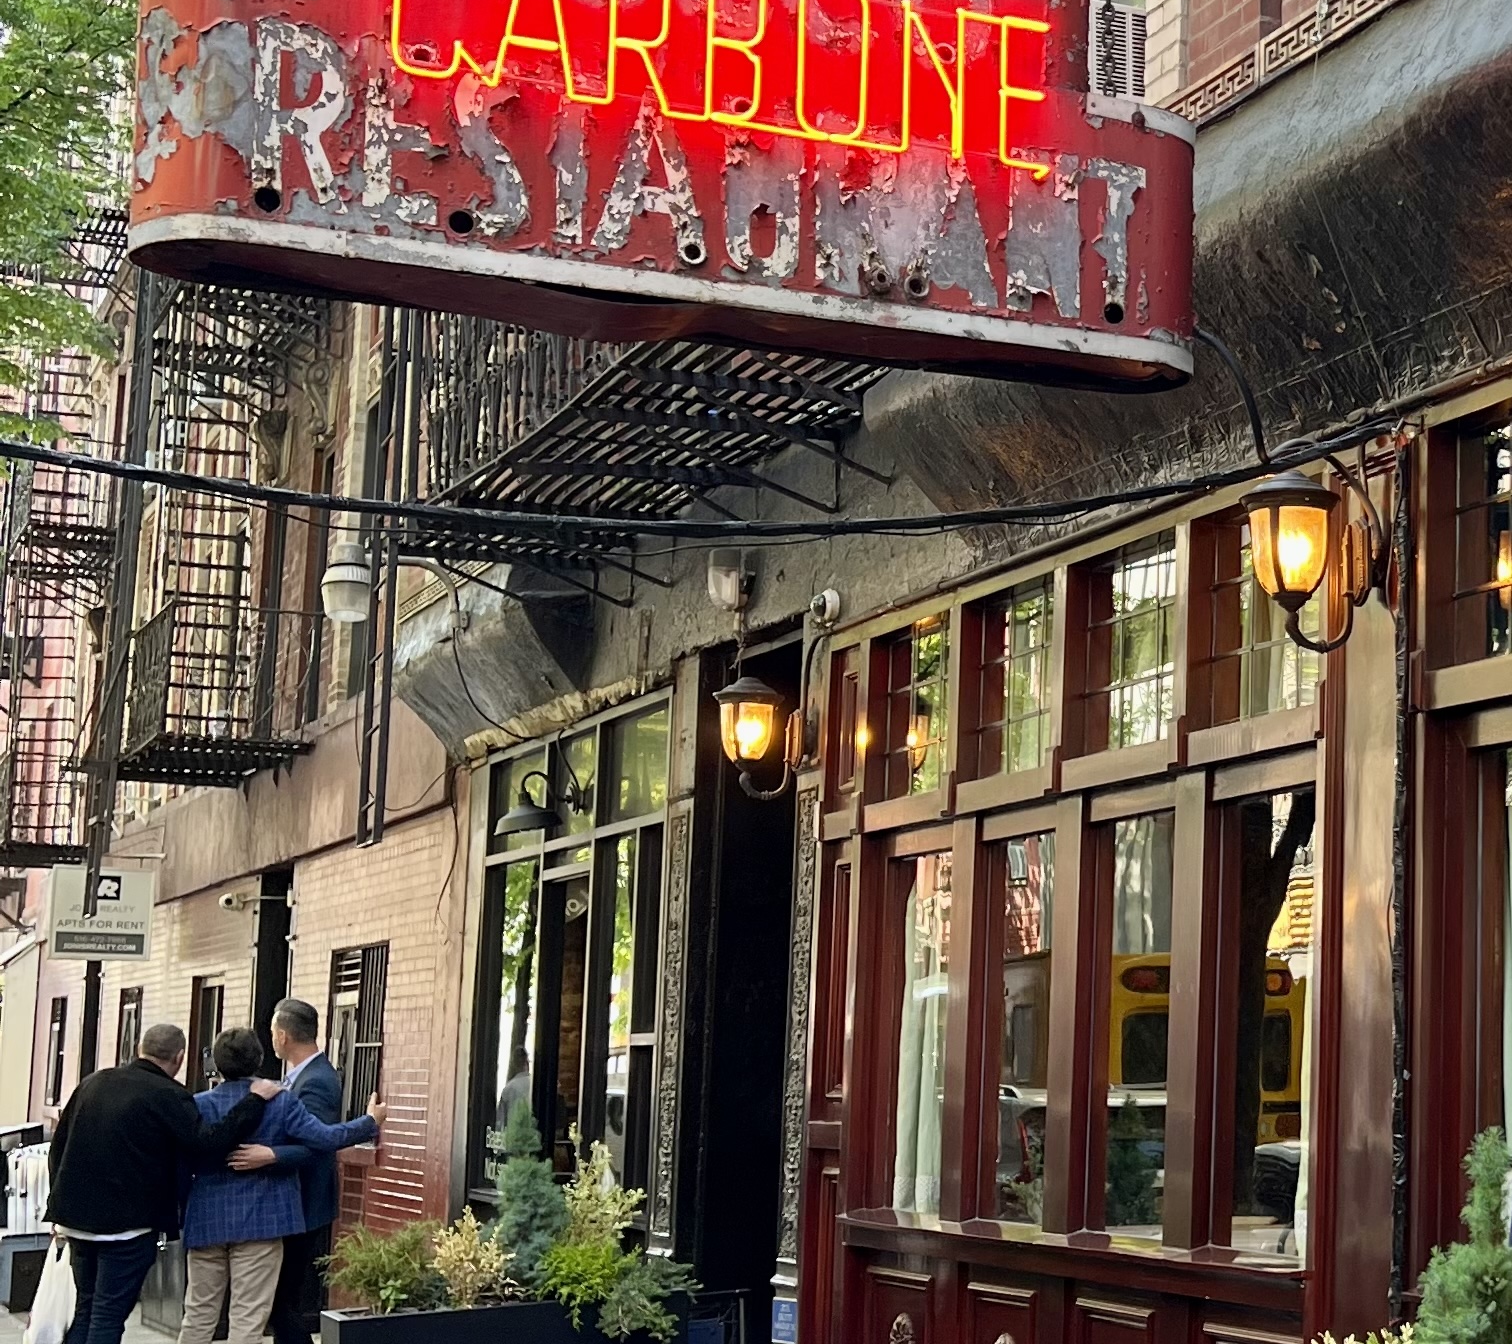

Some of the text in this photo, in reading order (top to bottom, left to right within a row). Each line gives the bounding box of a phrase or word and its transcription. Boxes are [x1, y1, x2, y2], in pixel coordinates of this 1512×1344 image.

[56, 918, 145, 930] APTS FOR RENT
